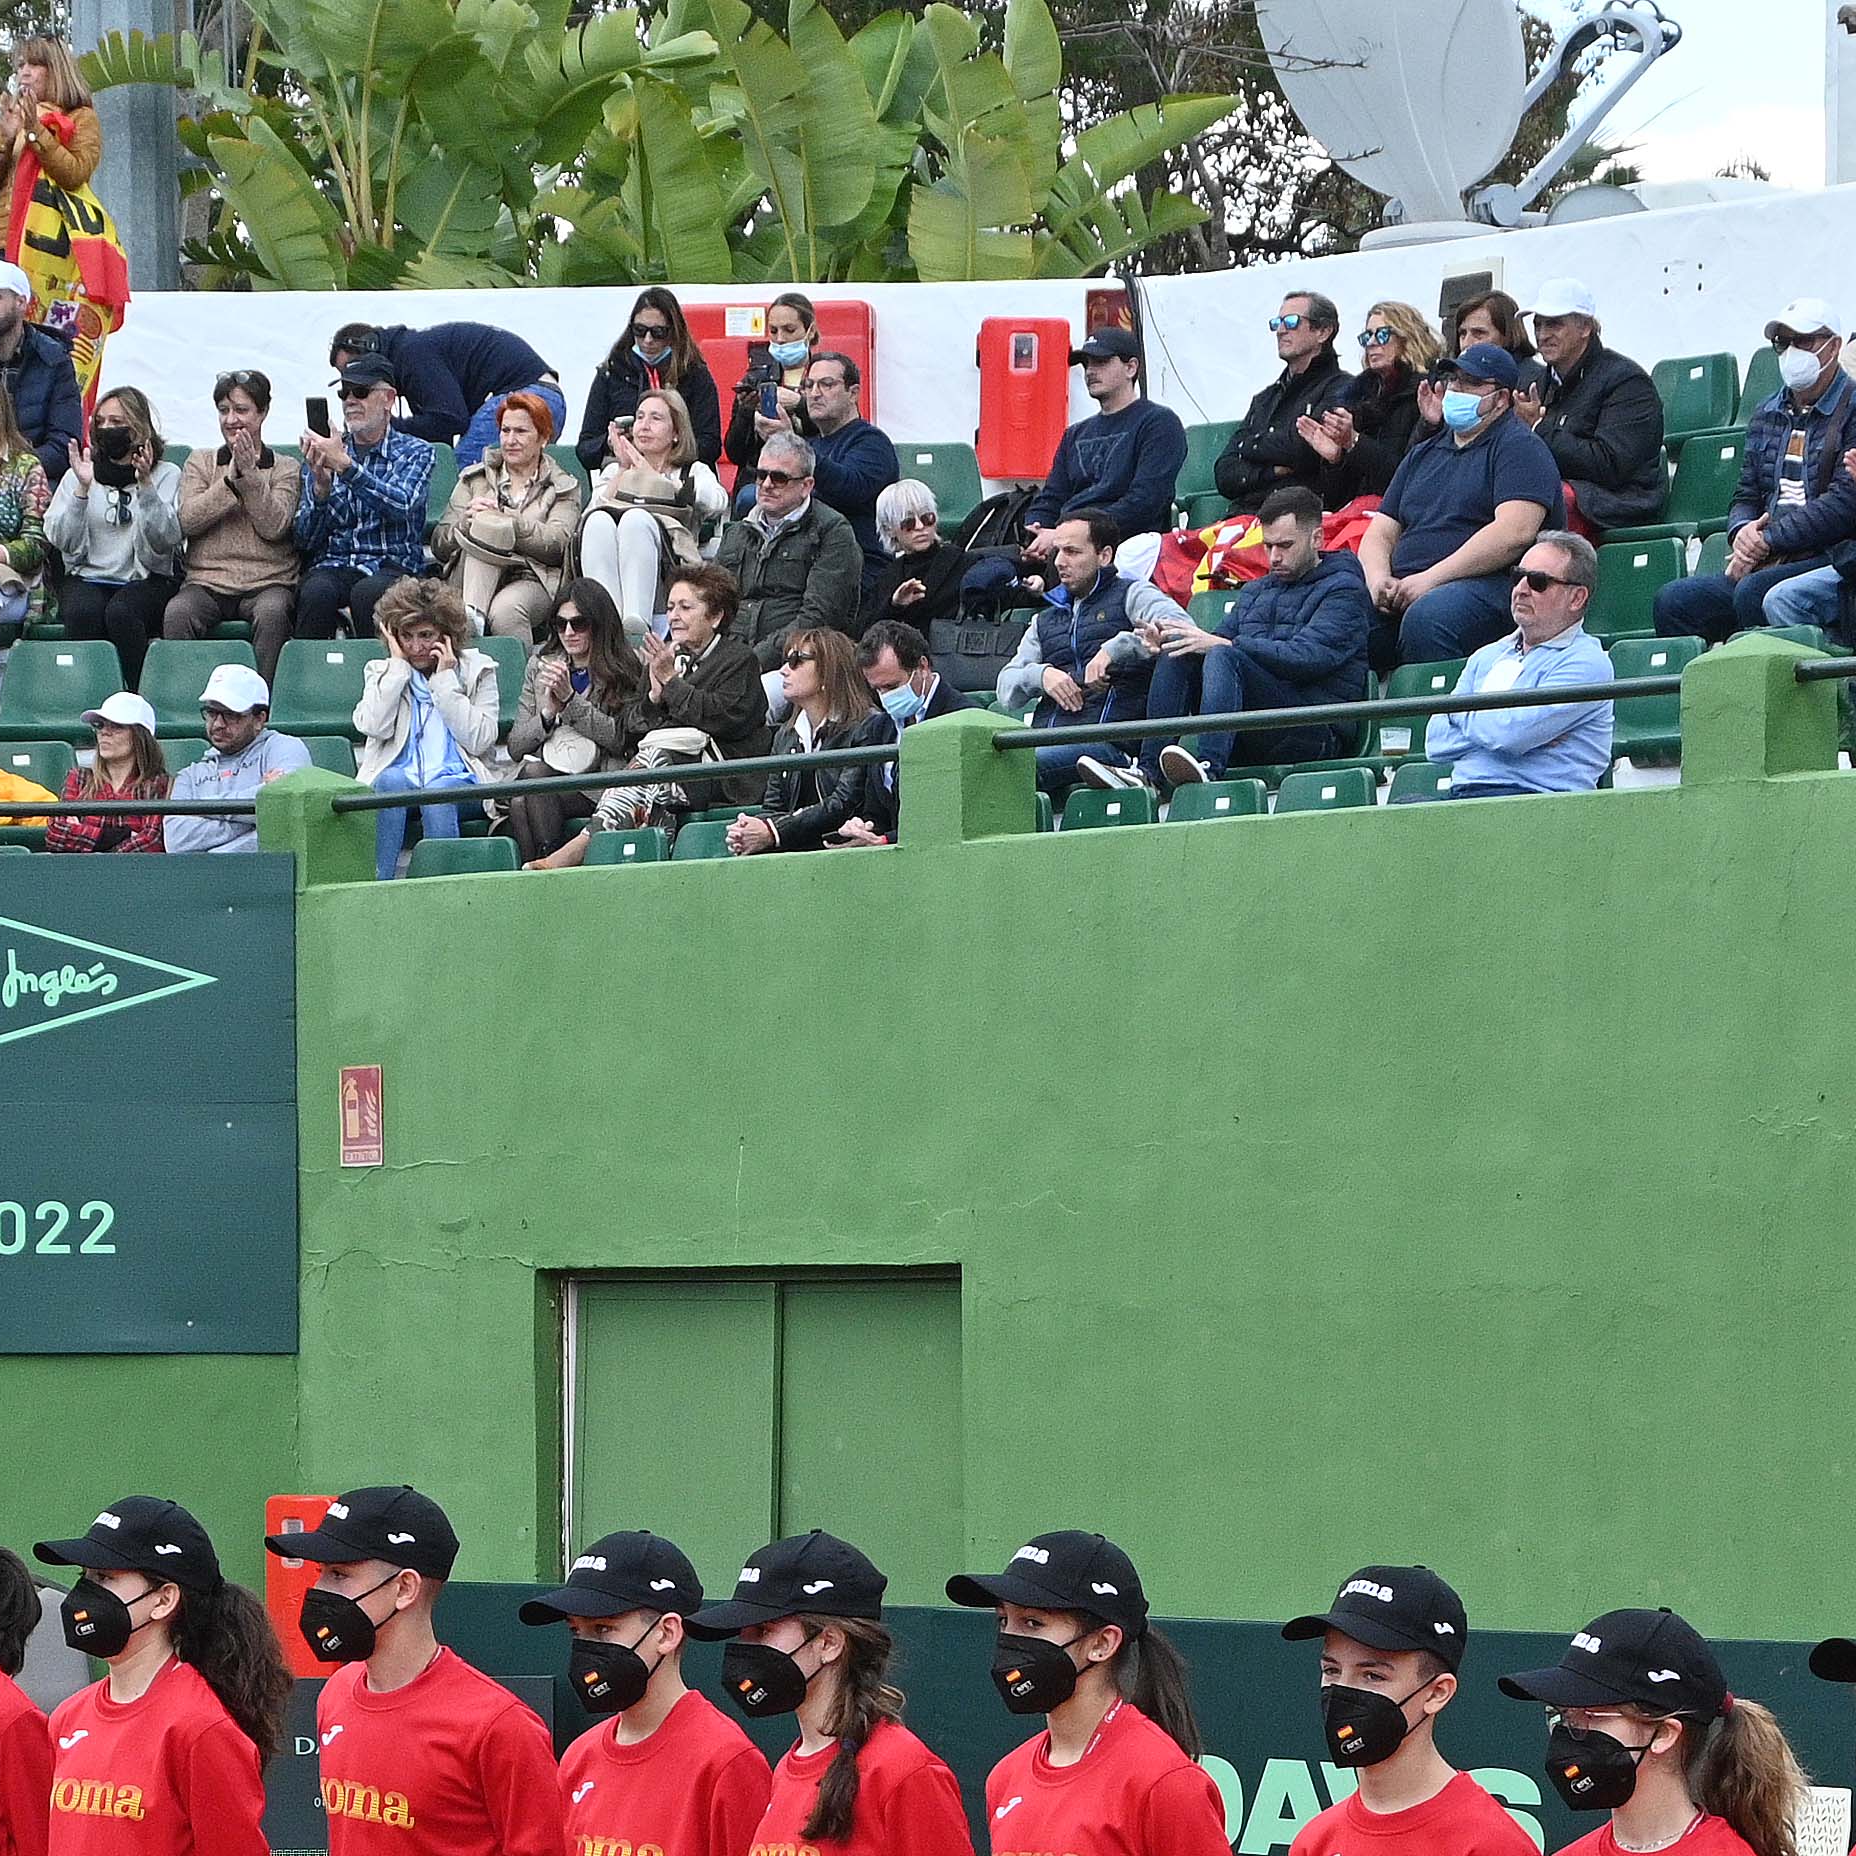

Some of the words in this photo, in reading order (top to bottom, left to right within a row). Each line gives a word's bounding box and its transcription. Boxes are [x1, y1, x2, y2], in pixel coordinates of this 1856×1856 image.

[1, 948, 118, 1008] Inglés
[50, 1776, 145, 1822] oma
[321, 1777, 415, 1830] oma
